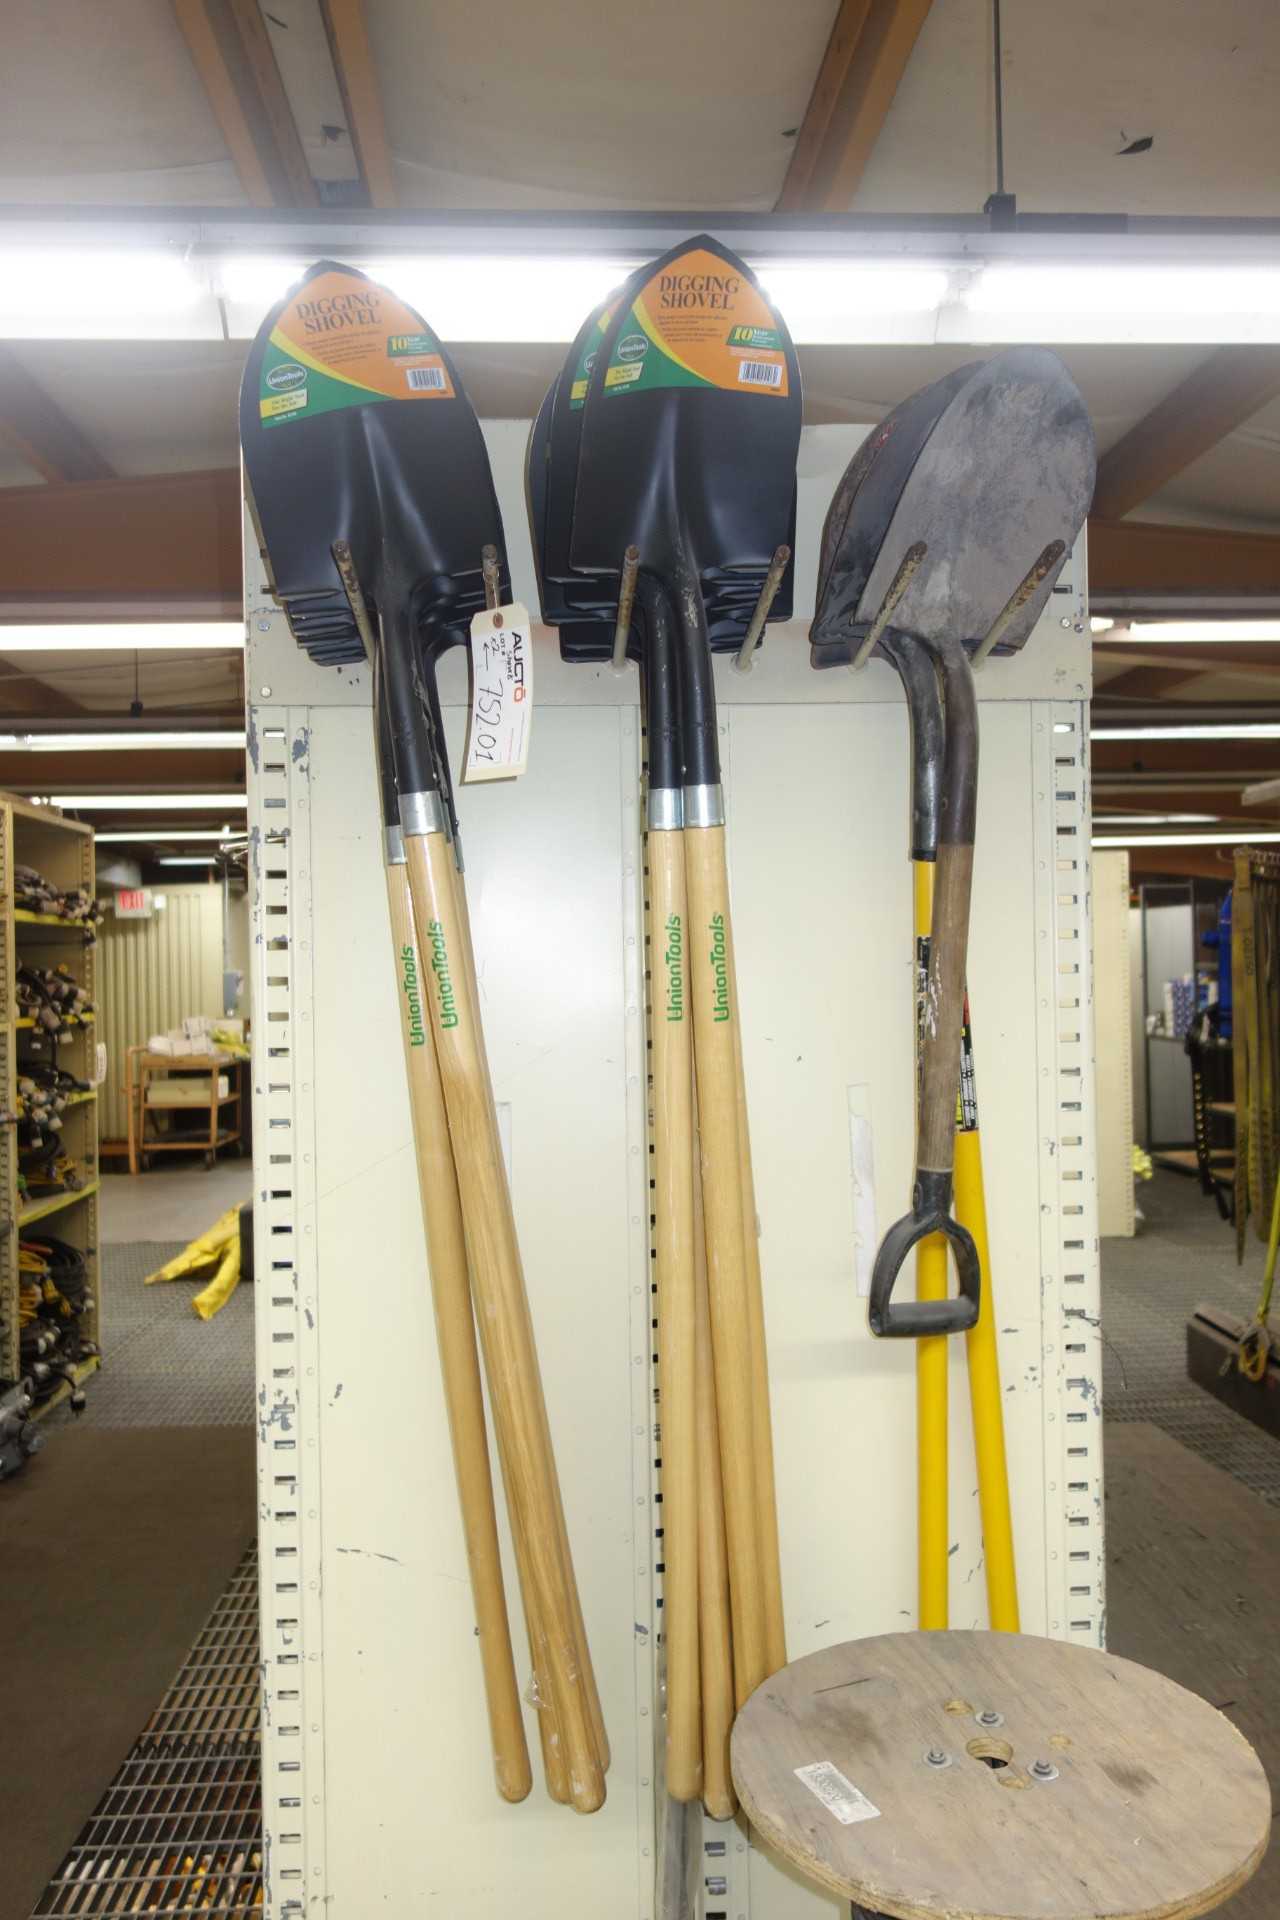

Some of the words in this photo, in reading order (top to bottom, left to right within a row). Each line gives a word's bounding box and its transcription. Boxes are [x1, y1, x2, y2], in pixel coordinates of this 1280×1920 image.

[659, 275, 740, 294] DIGGING
[296, 291, 380, 320] DIGGING
[660, 291, 736, 311] SHOVEL
[304, 308, 382, 334] SHOVEL
[734, 327, 752, 341] 10
[391, 337, 408, 352] 10
[475, 678, 504, 763] 752.01
[427, 920, 459, 1030] UnionTools
[665, 913, 683, 1022] UnionTools
[709, 912, 730, 1022] UnionTools
[401, 944, 425, 1047] UnionTools
